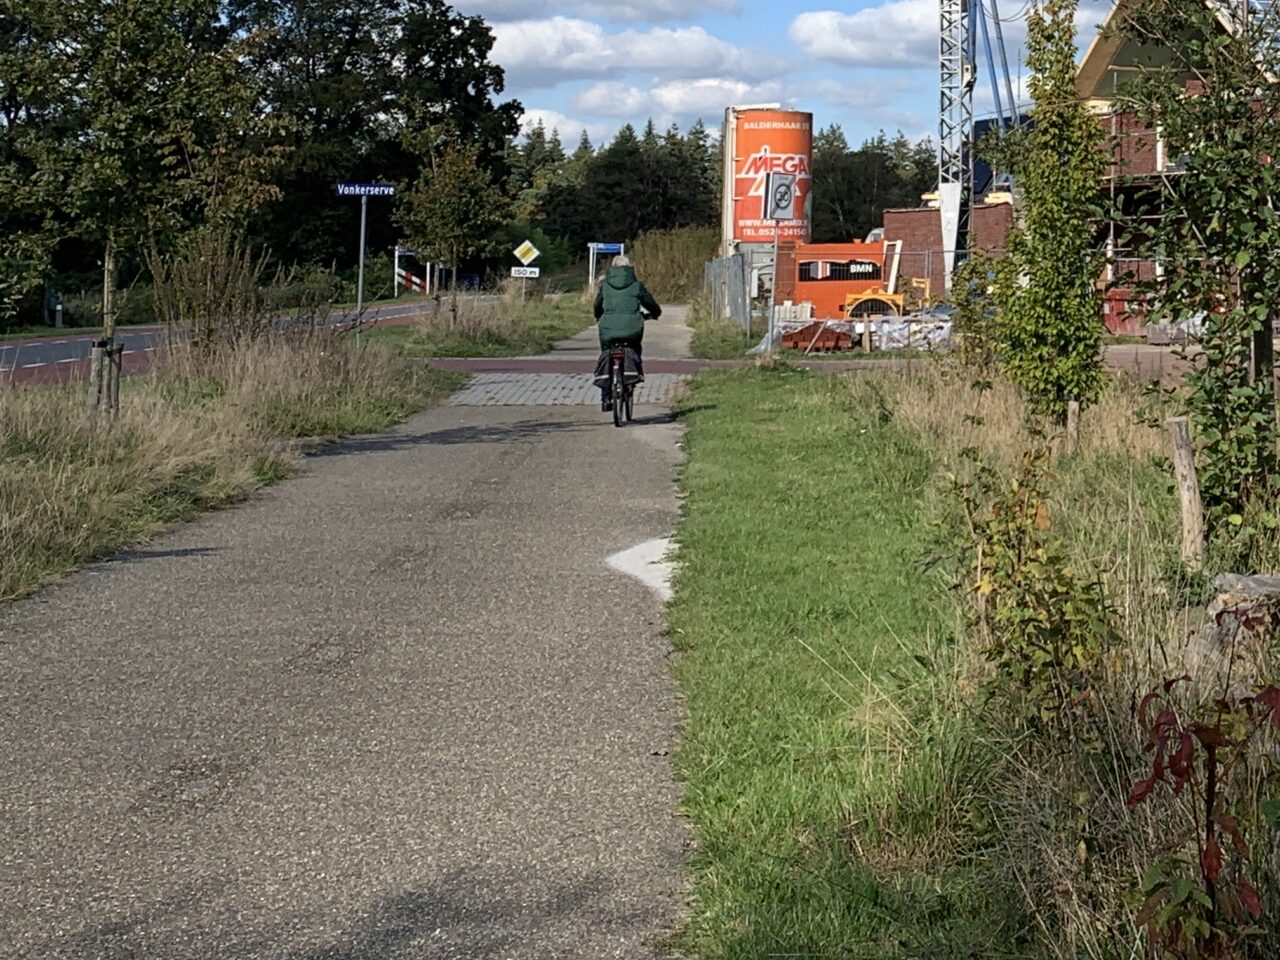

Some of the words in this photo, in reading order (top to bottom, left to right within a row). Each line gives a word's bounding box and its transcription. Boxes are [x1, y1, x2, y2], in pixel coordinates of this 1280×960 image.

[745, 156, 808, 174] MEGA
[337, 183, 395, 195] Vonkerserve
[850, 263, 873, 273] BMN
